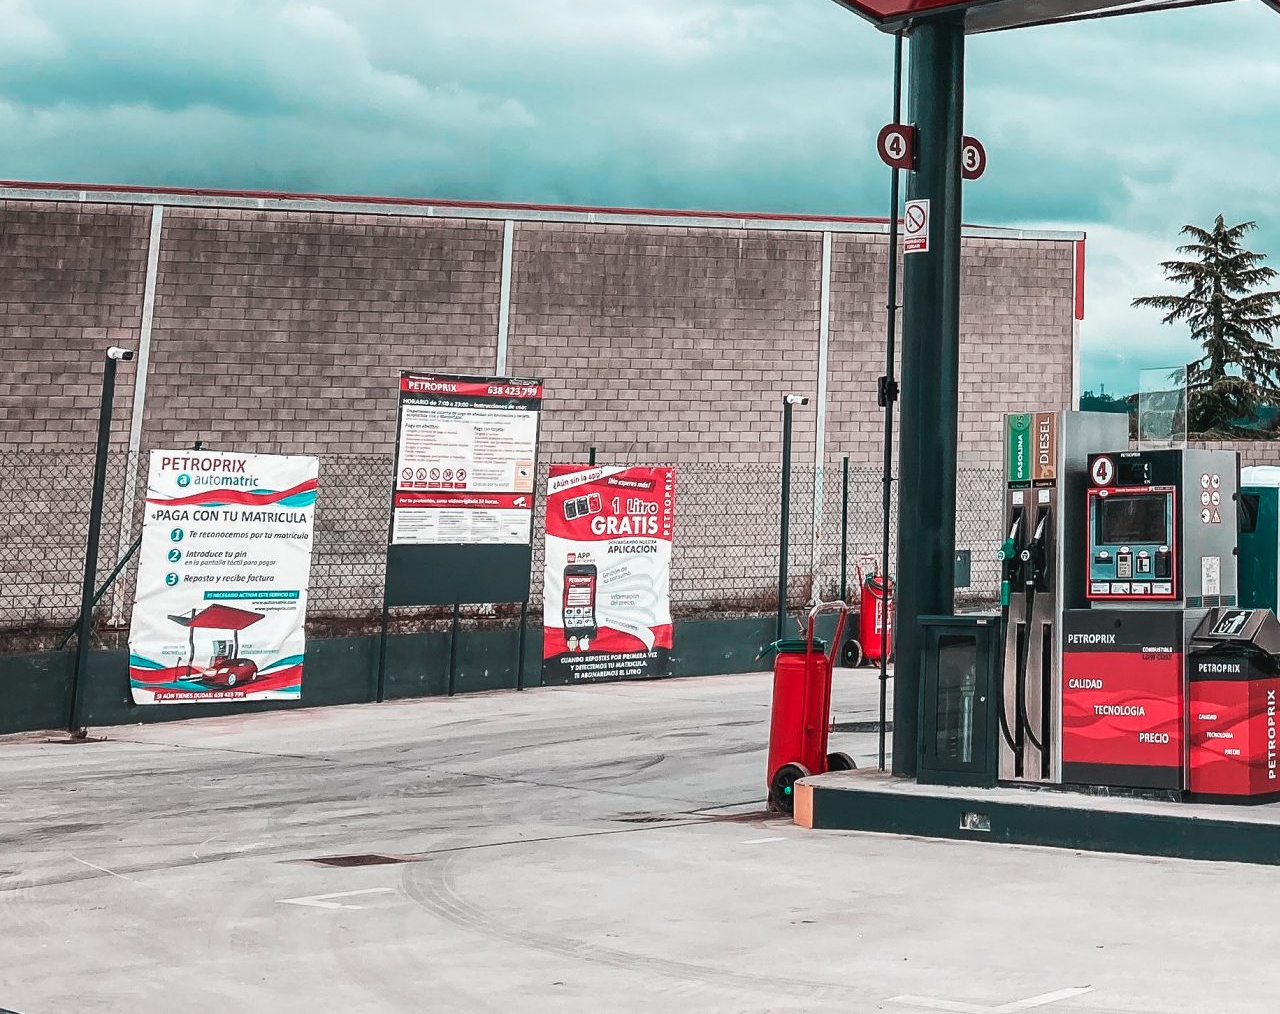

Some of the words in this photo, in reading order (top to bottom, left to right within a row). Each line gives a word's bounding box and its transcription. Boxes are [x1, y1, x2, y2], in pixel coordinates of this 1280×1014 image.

[889, 136, 902, 155] 4
[966, 148, 976, 168] 3
[408, 381, 457, 392] PETROPRIX
[487, 386, 503, 394] 638
[505, 387, 520, 395] 423
[522, 387, 537, 396] 799
[1016, 415, 1025, 429] 95
[1040, 417, 1050, 464] DIESEL
[161, 457, 246, 473] PETROPRIX
[1096, 461, 1107, 480] 4
[194, 474, 259, 486] automatric
[553, 477, 569, 489] ¿Aún
[570, 476, 580, 484] sin
[588, 470, 603, 481] app?
[611, 497, 620, 514] 1
[626, 497, 658, 515] Litro
[663, 471, 673, 536] PETROPRIX
[156, 510, 189, 521] PAGA
[193, 510, 219, 522] CON
[223, 511, 238, 522] TU
[241, 511, 307, 523] MATRICULA
[591, 516, 658, 535] GRATIS
[189, 531, 197, 539] Te
[199, 532, 249, 540] reconocemos
[250, 533, 263, 541] por
[170, 550, 179, 561] 2
[185, 550, 223, 558] Introduce
[235, 550, 247, 559] pin
[607, 545, 657, 554] APLICACION
[168, 574, 176, 585] 3
[183, 574, 214, 584] Reposta
[215, 576, 221, 584] y
[222, 574, 244, 582] recibe
[245, 574, 275, 584] factura
[1068, 634, 1116, 644] PETROPRIX
[1198, 663, 1240, 673] PETROPRIX
[1068, 678, 1103, 689] CALIDAD
[1094, 705, 1145, 716] TECNOLOGIA
[1139, 732, 1169, 744] PRECIO
[1267, 689, 1277, 780] PETROPRIX
